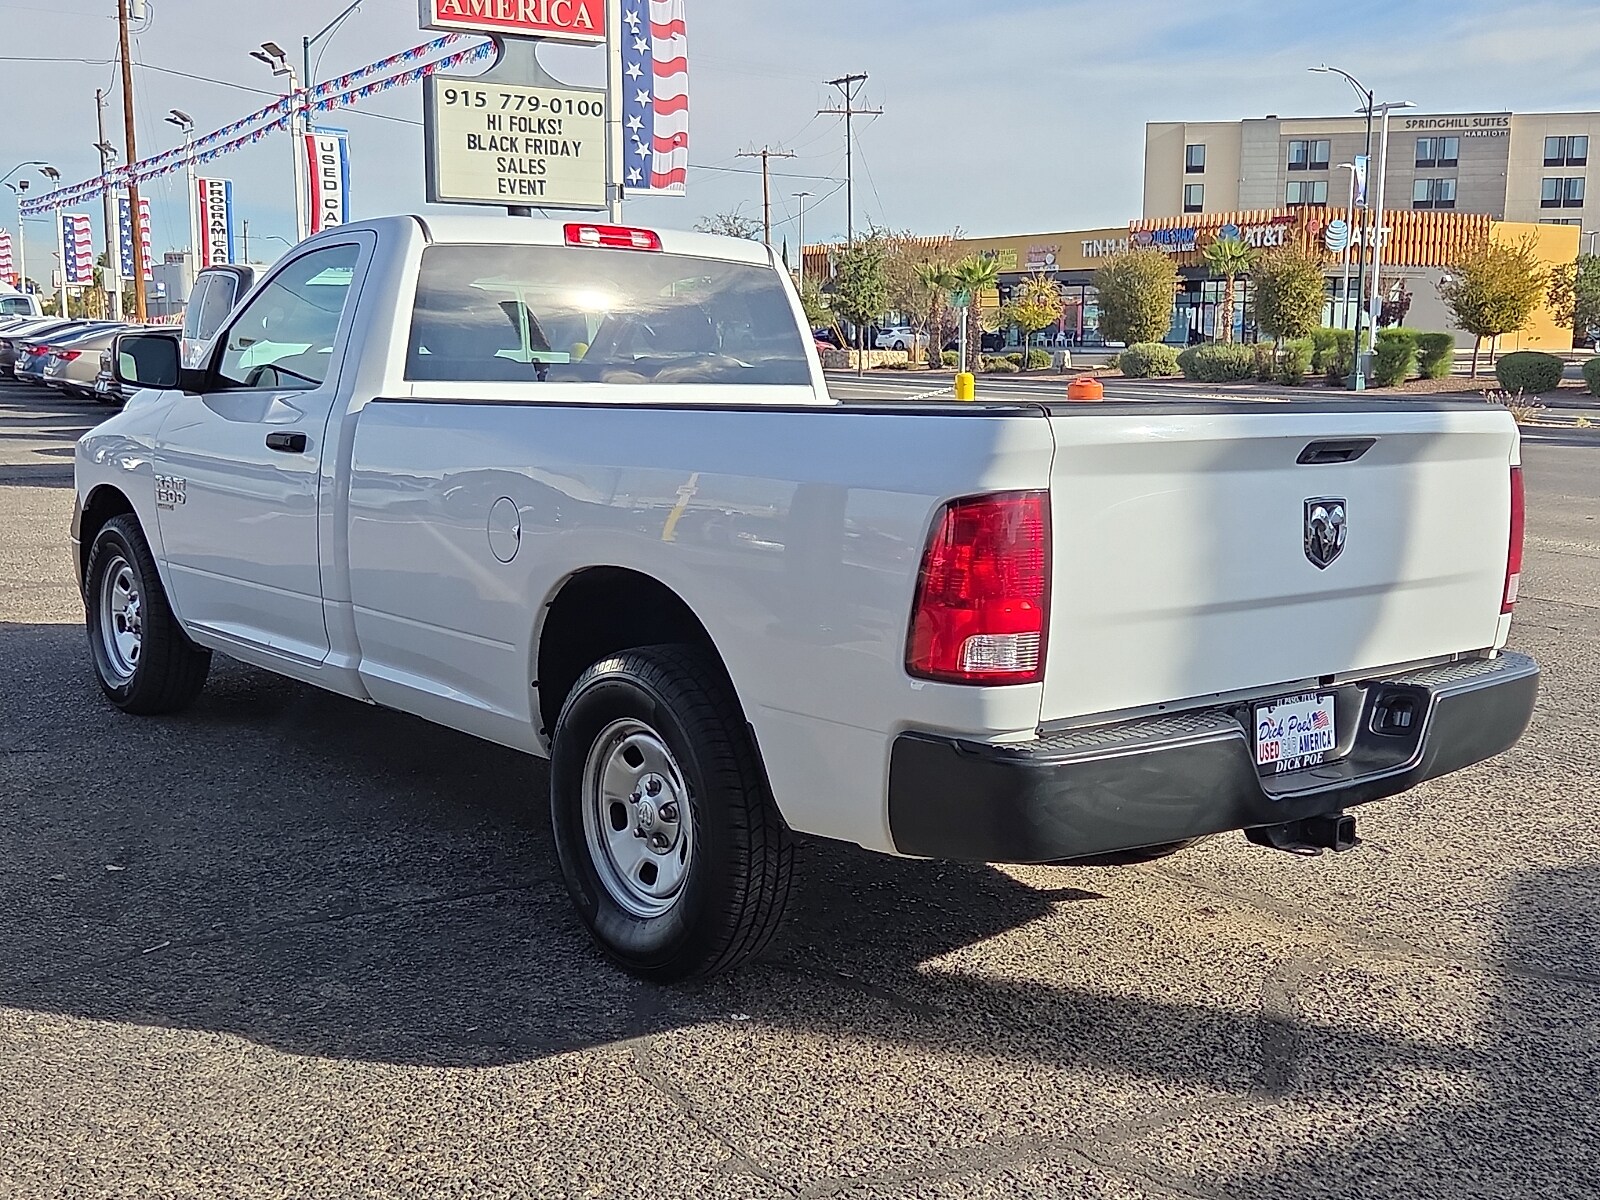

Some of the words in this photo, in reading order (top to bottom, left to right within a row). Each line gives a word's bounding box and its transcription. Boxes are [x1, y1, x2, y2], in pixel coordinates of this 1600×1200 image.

[440, 0, 594, 29] AMERICA
[444, 88, 487, 108] 915
[499, 93, 604, 117] 779-0100
[487, 114, 502, 131] HI
[509, 116, 563, 135] FOLKS!
[1405, 119, 1469, 129] SPRINGHILL
[1472, 117, 1509, 127] SUITES
[467, 133, 519, 153] BLACK
[525, 137, 582, 157] FRIDAY
[320, 142, 337, 190] USED
[497, 157, 547, 175] SALES
[498, 178, 547, 196] EVENT
[209, 181, 226, 235] PROGRAM
[1245, 224, 1287, 247] AT&T
[1259, 718, 1284, 741] Dick
[1259, 741, 1280, 762] USED
[1299, 729, 1332, 753] AMERICA
[1275, 757, 1301, 772] DICK
[1303, 752, 1323, 766] POE
